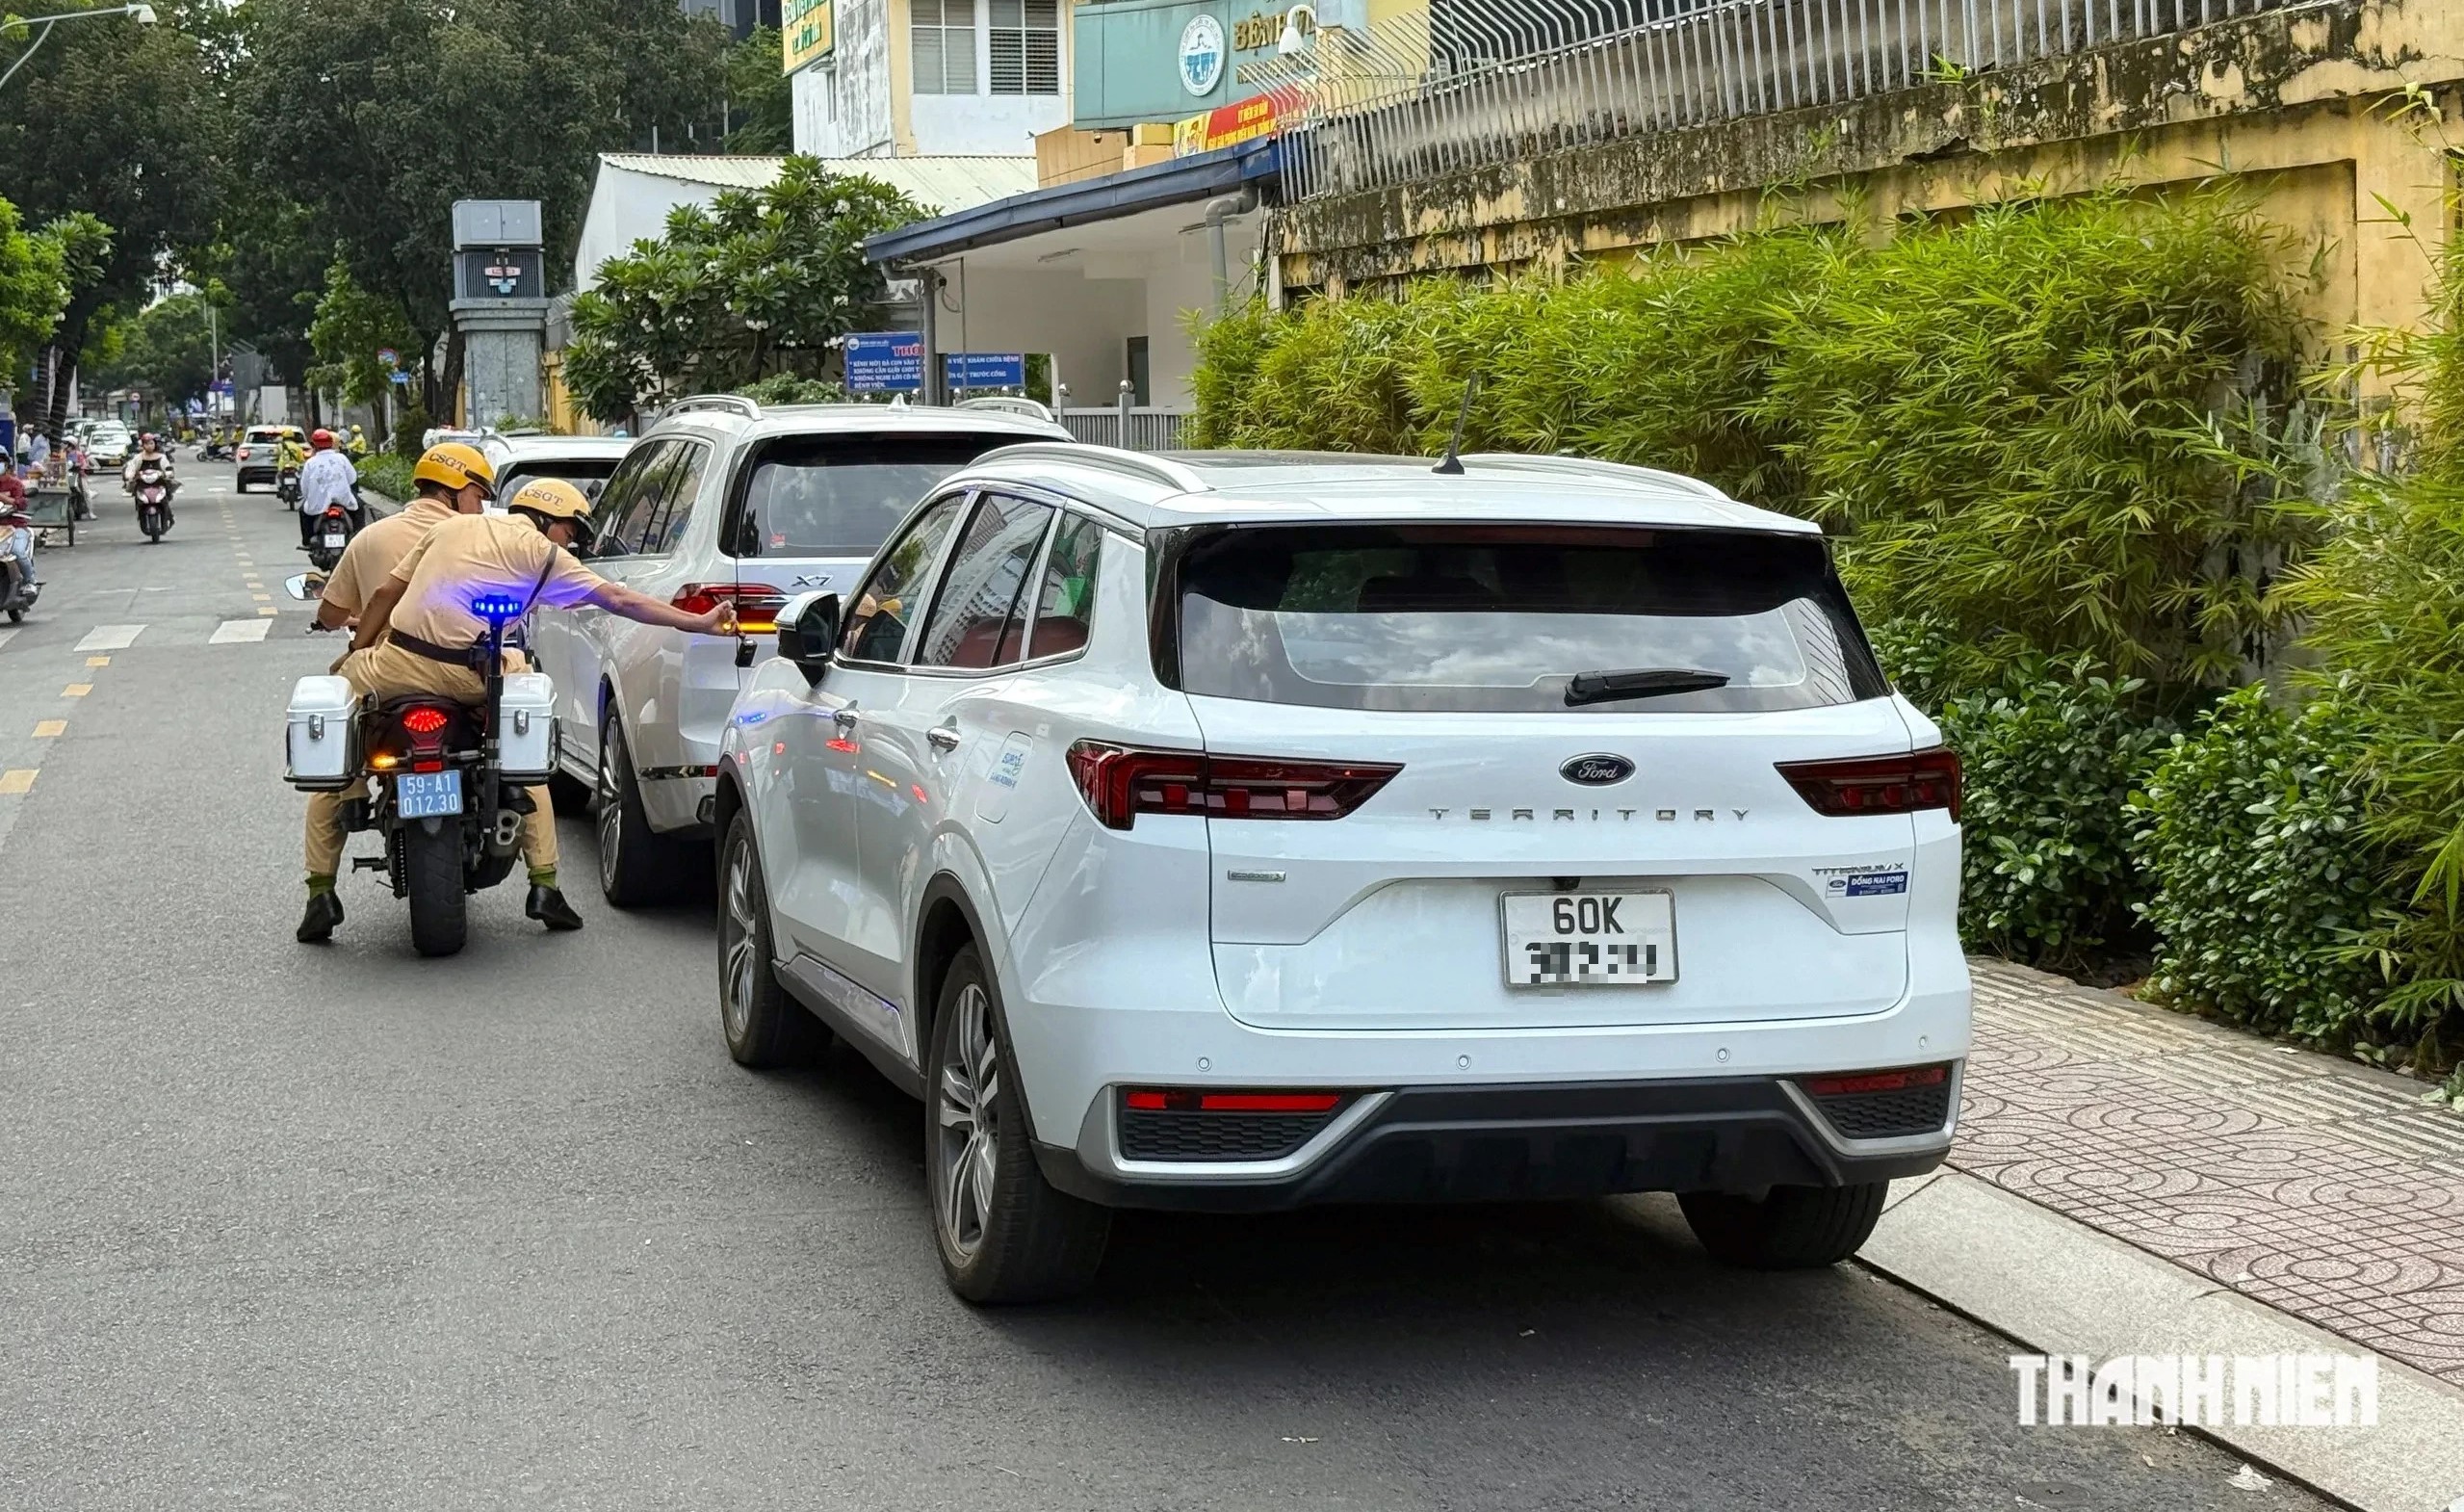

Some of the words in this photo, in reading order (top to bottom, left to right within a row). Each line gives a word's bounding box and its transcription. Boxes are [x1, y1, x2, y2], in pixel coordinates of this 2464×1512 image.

[892, 343, 924, 357] THÔ
[428, 452, 467, 473] CSGT
[524, 487, 564, 508] CSGT
[791, 574, 835, 587] X7
[1576, 759, 1620, 779] Ford
[406, 773, 452, 795] 59-A1
[403, 793, 458, 816] 012.30
[1428, 807, 1751, 821] TERRITORY
[1893, 862, 1905, 871] X
[1873, 876, 1886, 885] NAI
[1886, 874, 1905, 884] FORD
[1552, 897, 1625, 935] 60K
